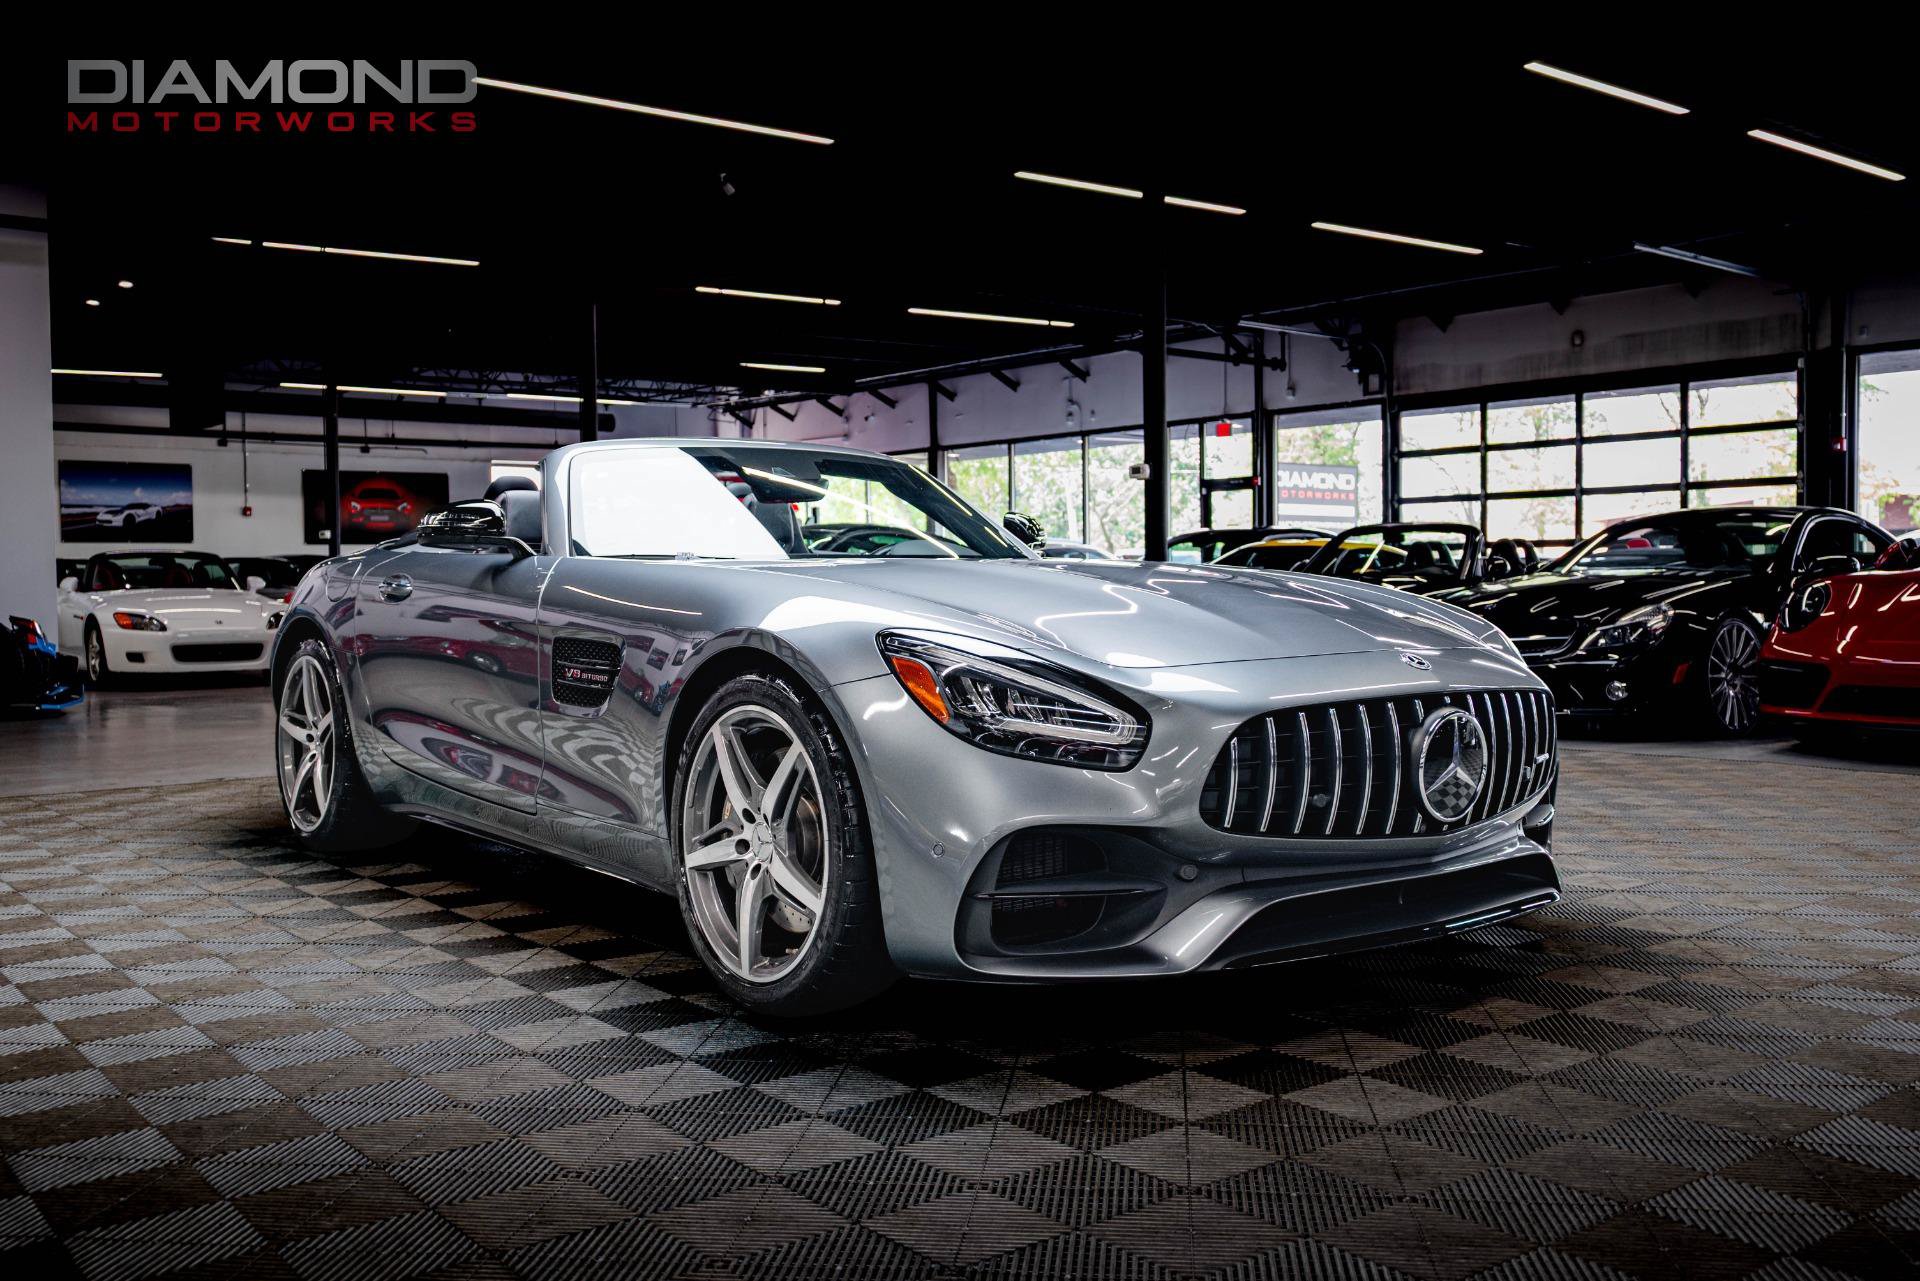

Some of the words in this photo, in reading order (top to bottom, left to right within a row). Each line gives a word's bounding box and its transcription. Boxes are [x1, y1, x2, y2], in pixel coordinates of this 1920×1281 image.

[1281, 489, 1355, 500] OTORWORKS
[565, 668, 581, 678] V8
[581, 673, 608, 682] BITURBO
